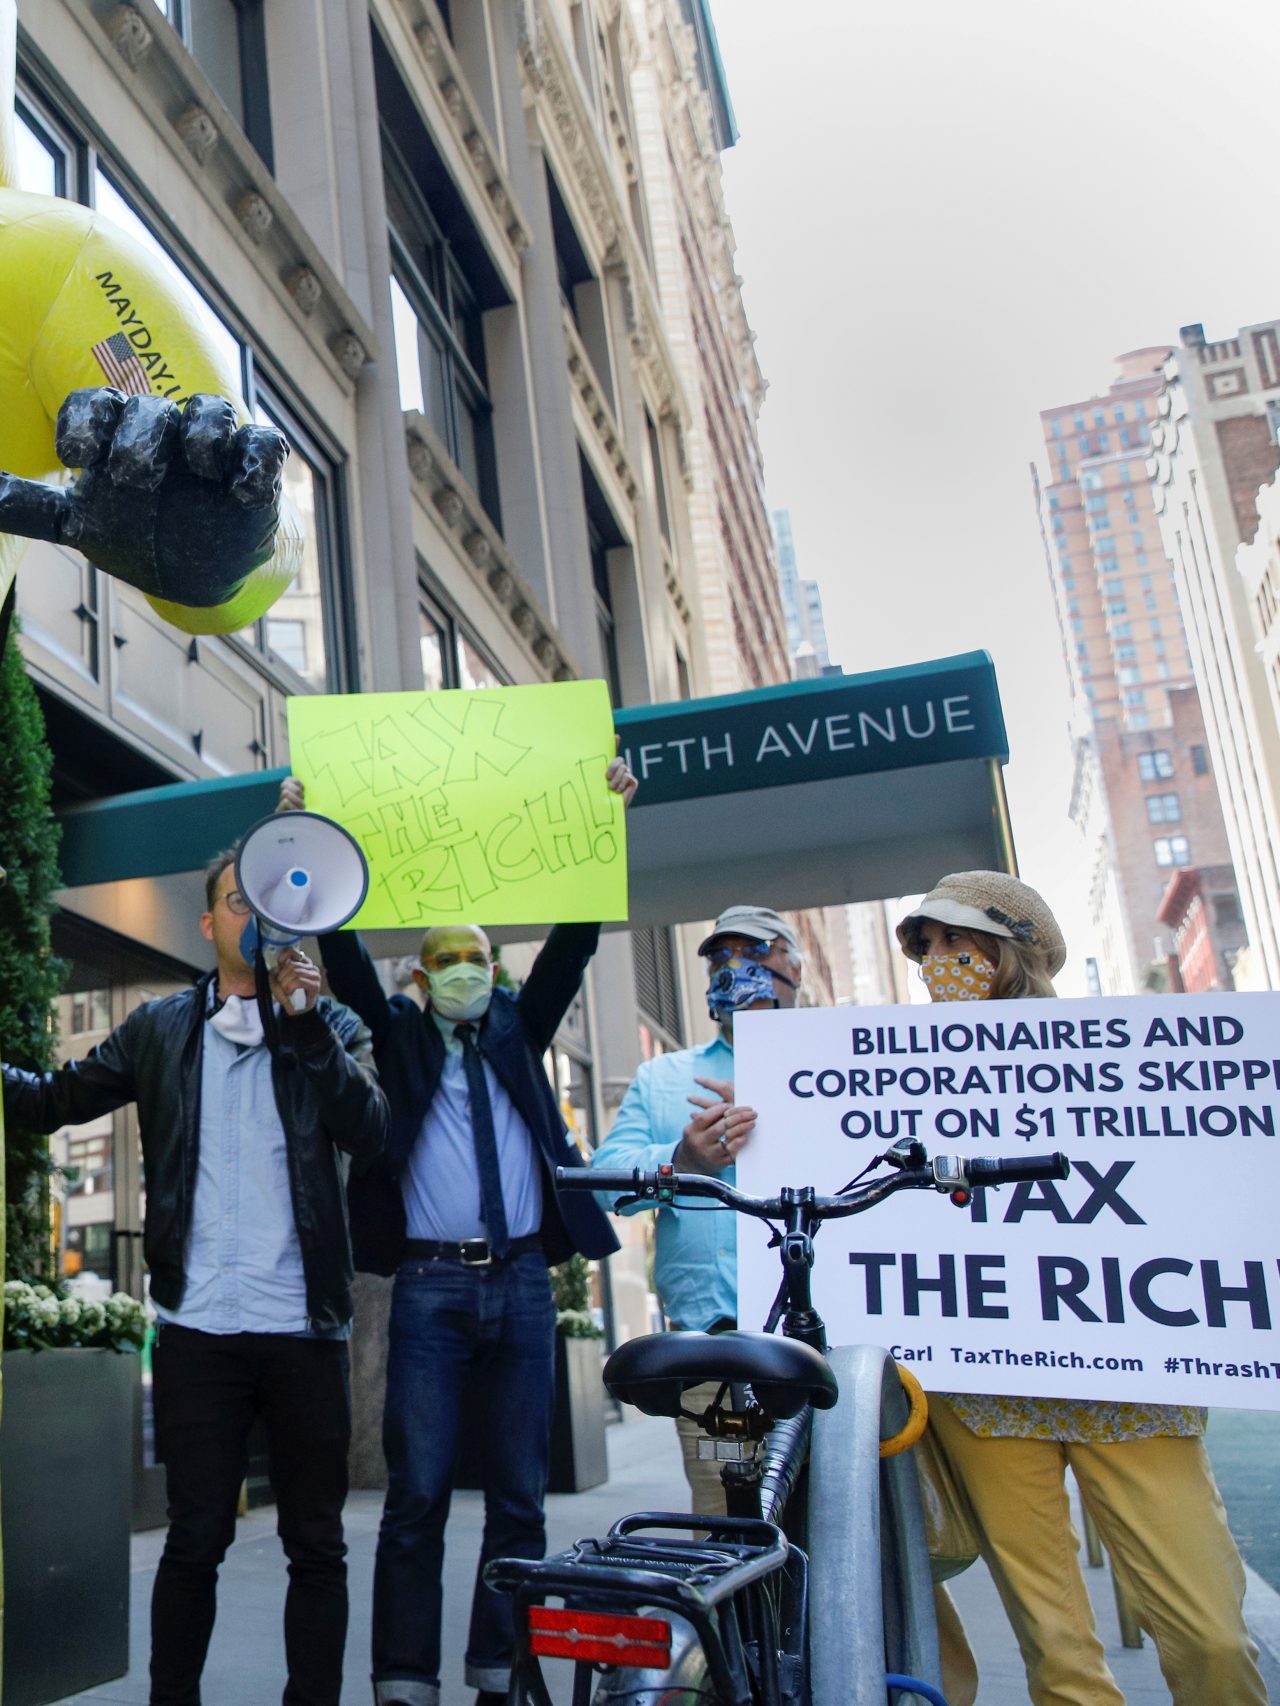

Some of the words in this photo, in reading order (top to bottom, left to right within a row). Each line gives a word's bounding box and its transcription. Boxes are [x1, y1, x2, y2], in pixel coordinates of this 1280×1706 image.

[302, 698, 533, 808] TAX
[624, 732, 734, 780] IFTH
[756, 696, 976, 763] AVENUE
[342, 788, 463, 862] THE
[378, 754, 617, 924] RICH!
[852, 1018, 1131, 1056] BILLIONAIRES
[1144, 1016, 1244, 1046] AND
[789, 1062, 1124, 1098] CORPORATIONS
[841, 1109, 922, 1139] OUT
[935, 1108, 1000, 1138] ON
[1015, 1103, 1056, 1142] $1
[1067, 1104, 1276, 1138] TRILLION
[848, 1252, 1009, 1320] THE
[1037, 1257, 1280, 1331] RICH
[950, 1347, 1144, 1373] TaxTheRich.com
[1164, 1356, 1280, 1380] #ThrashT
